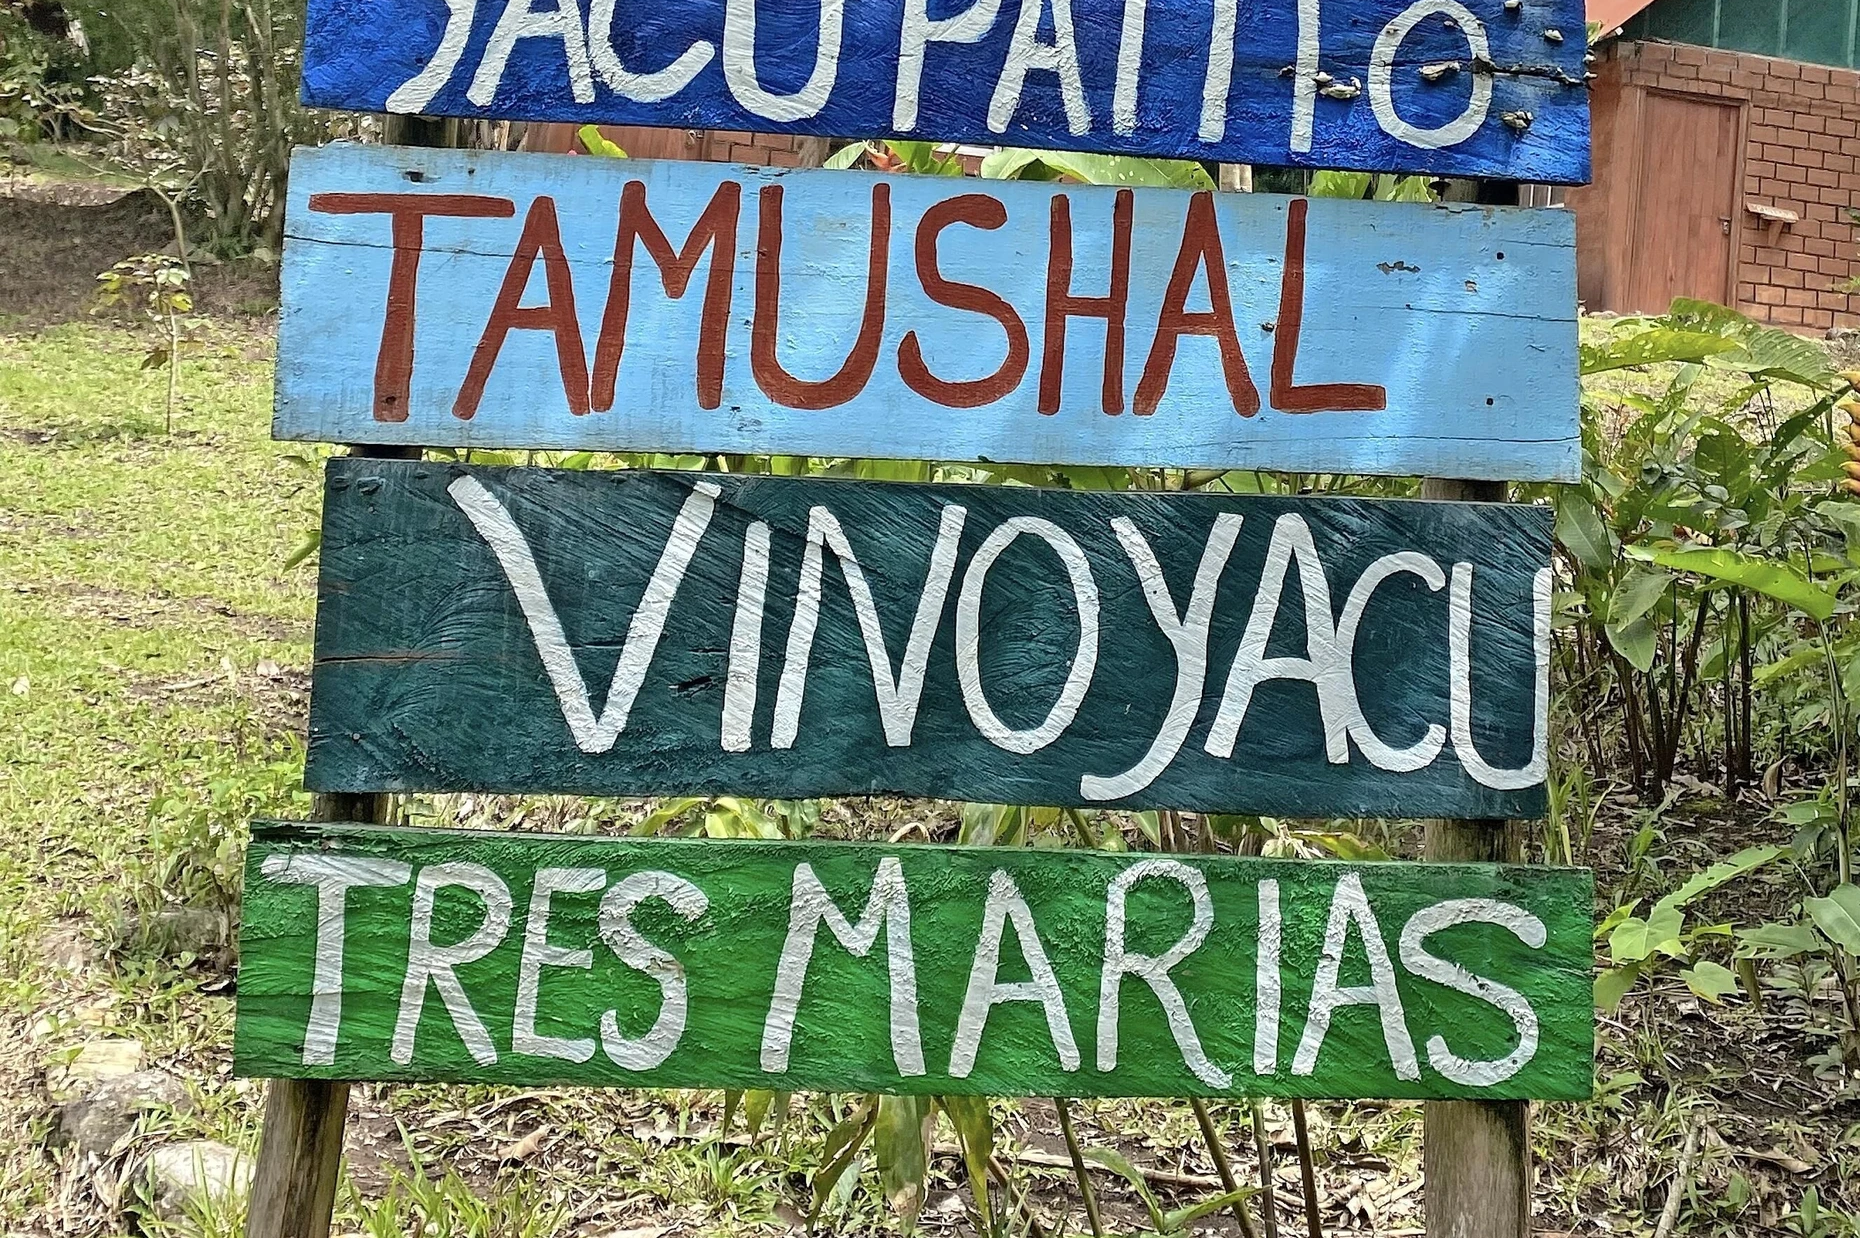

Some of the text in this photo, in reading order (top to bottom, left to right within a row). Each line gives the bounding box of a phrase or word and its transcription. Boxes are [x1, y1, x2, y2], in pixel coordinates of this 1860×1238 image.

[307, 179, 1387, 423] TAMUSHAL
[446, 474, 1552, 801] VINOYACU
[259, 853, 1548, 1090] TRES MARIAS
